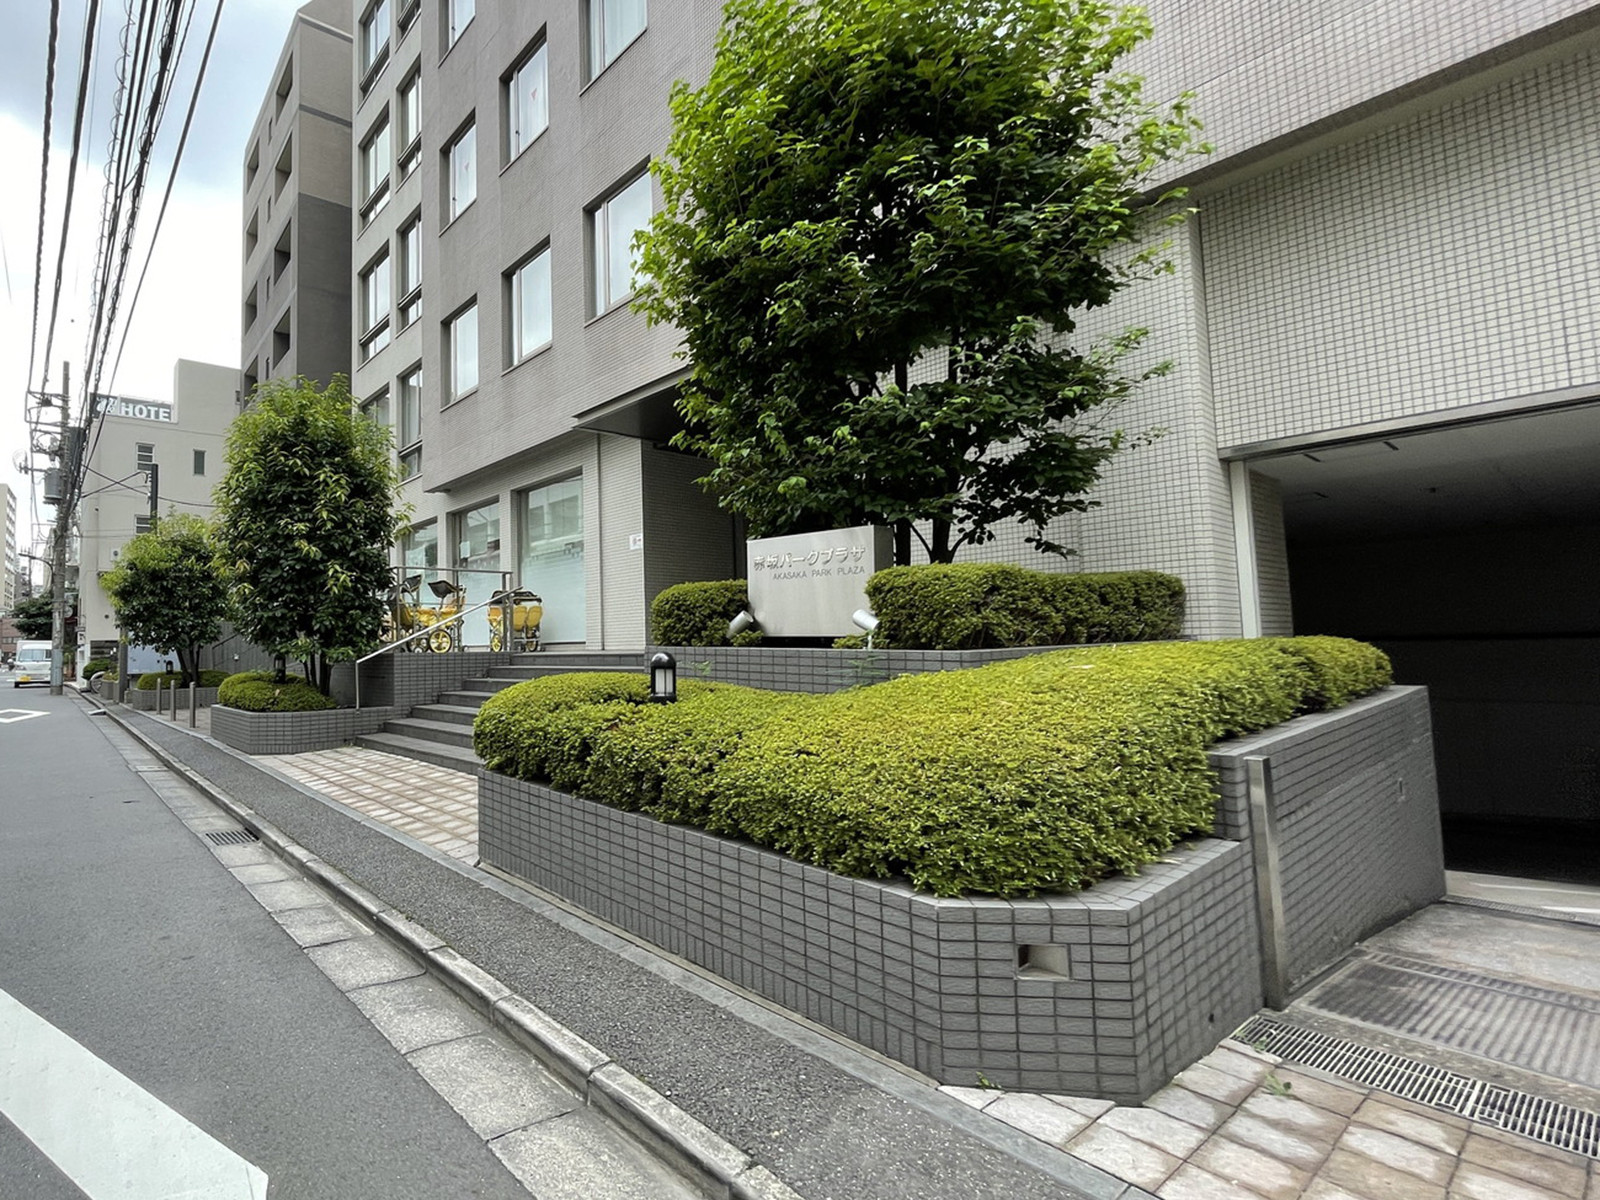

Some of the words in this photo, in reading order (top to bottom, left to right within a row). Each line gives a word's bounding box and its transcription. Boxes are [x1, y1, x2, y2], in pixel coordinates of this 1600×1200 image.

[773, 571, 807, 580] AKASAKA
[811, 568, 832, 577] PARK
[837, 566, 865, 575] PLAZA
